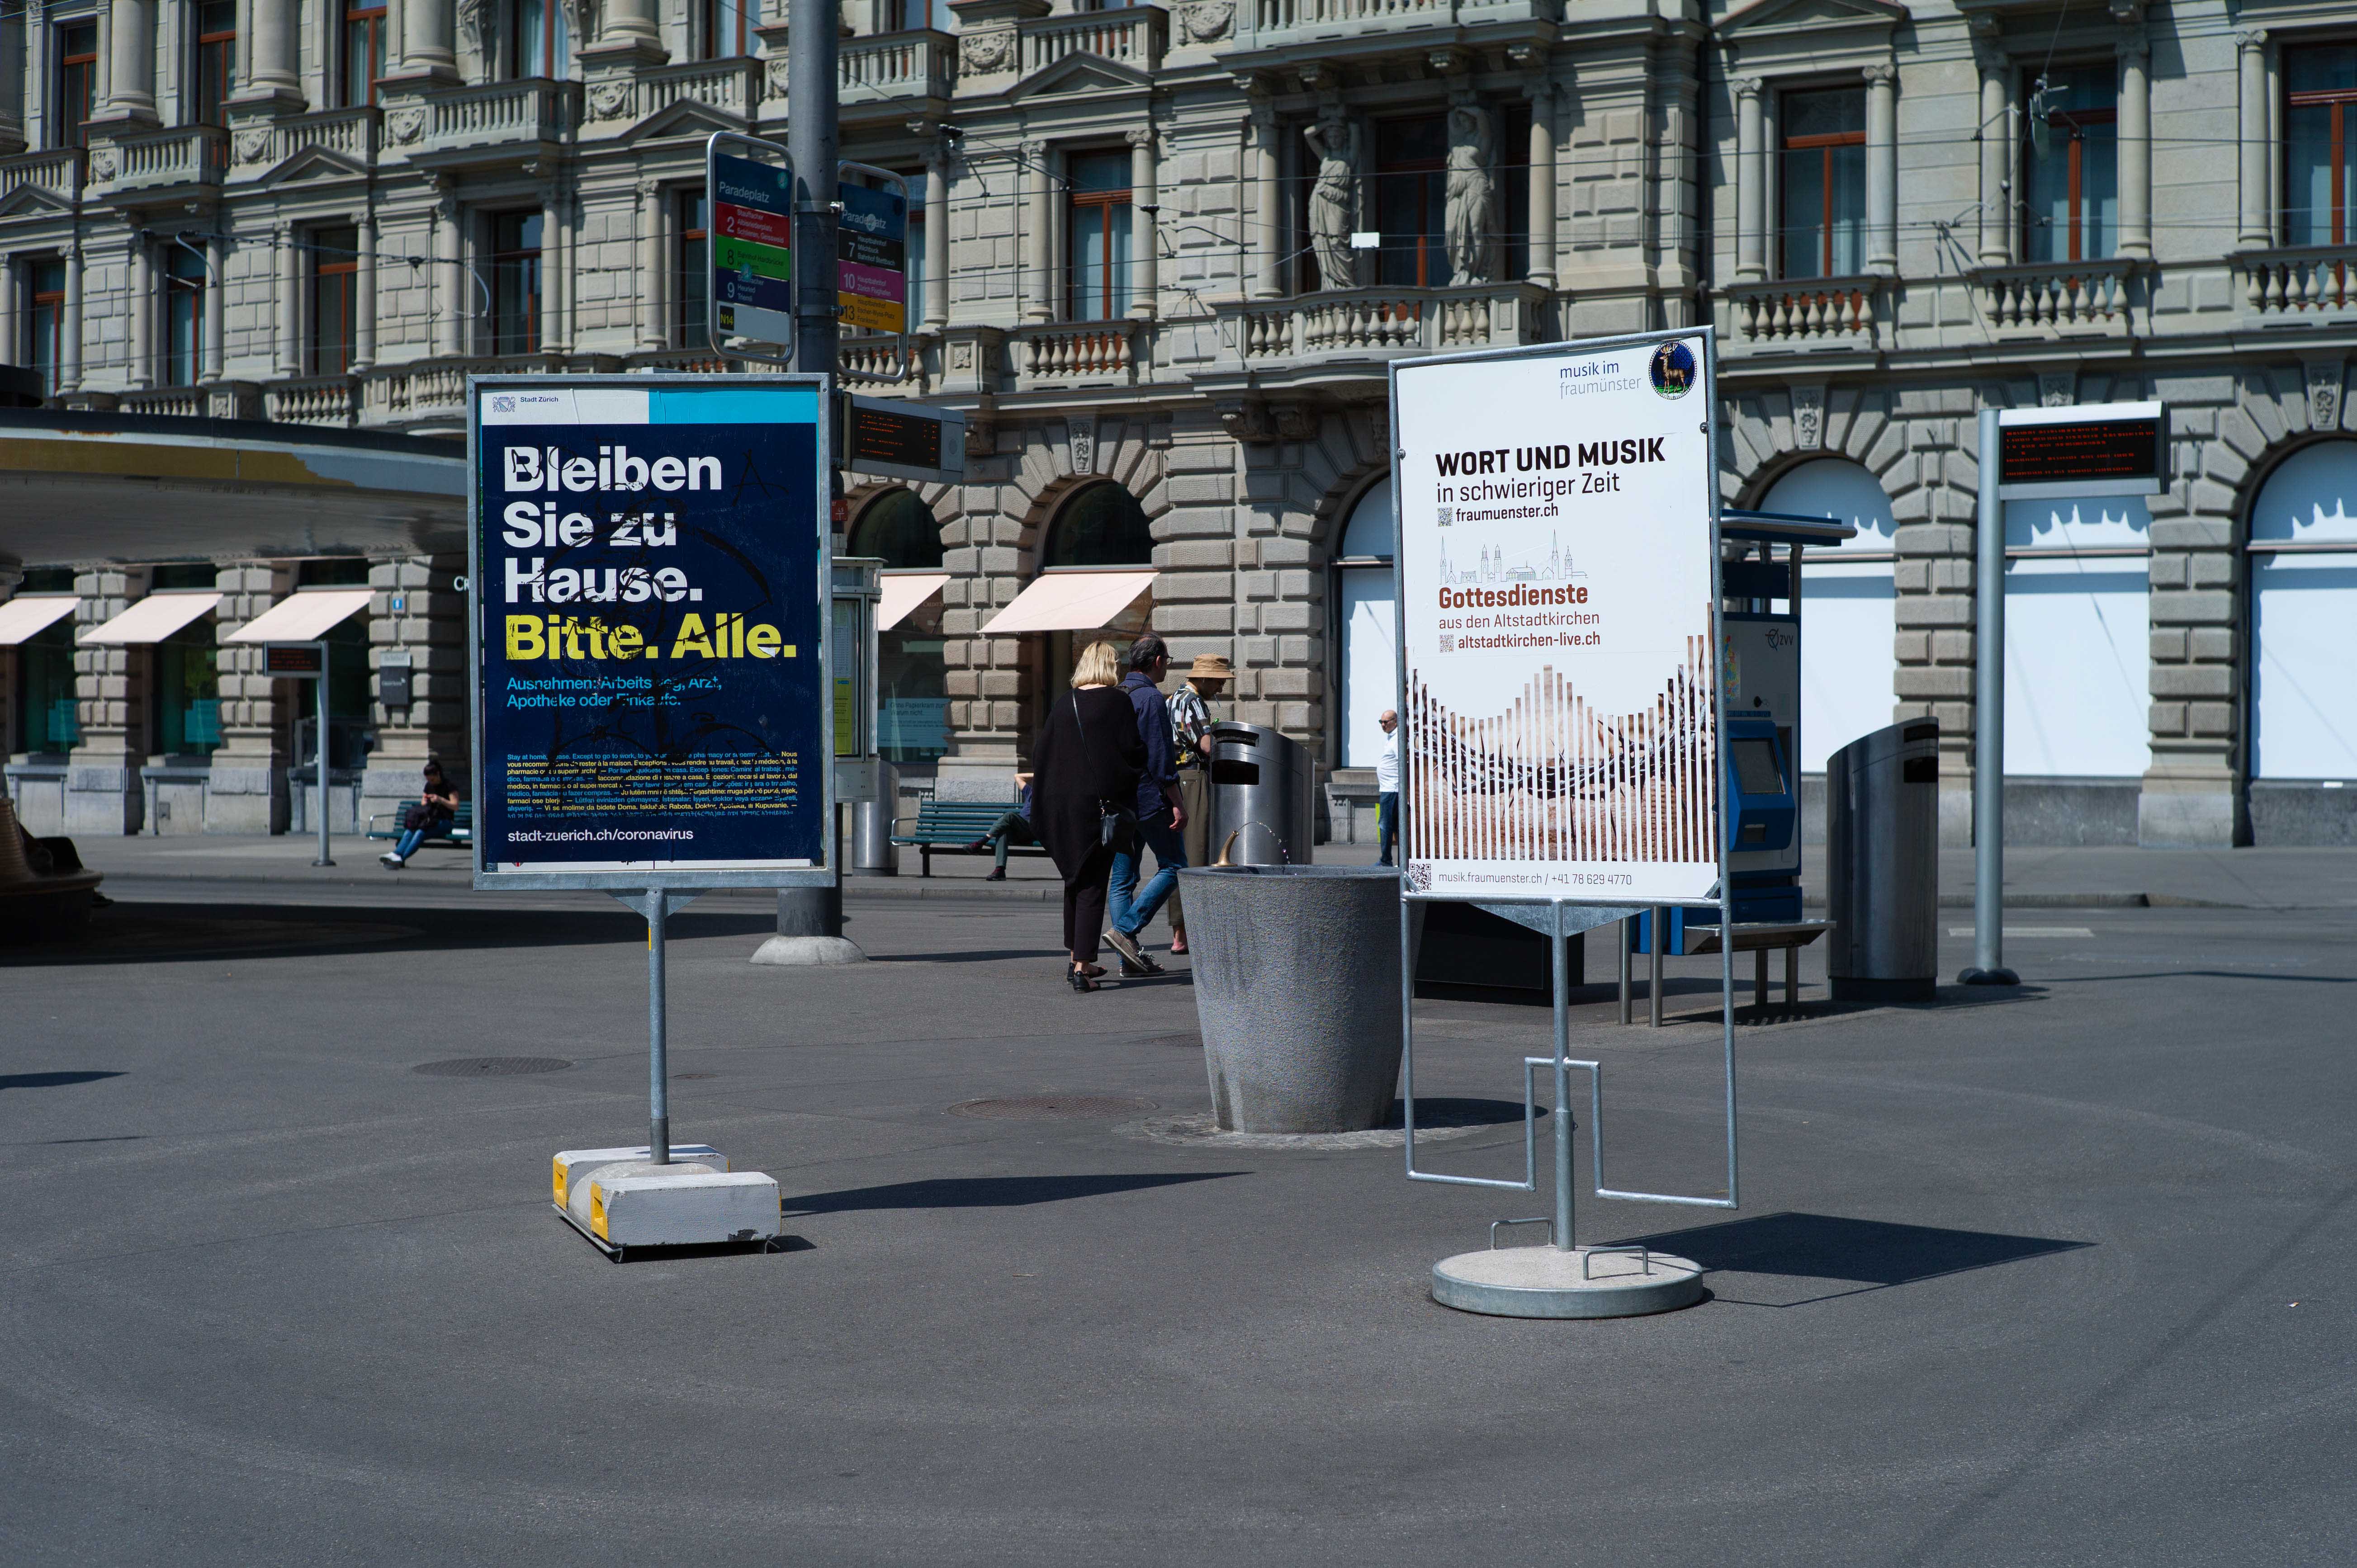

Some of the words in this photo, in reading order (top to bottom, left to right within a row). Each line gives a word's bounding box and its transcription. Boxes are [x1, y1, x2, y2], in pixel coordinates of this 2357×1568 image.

[719, 182, 769, 203] Paradeplatz
[727, 216, 734, 233] 2
[842, 210, 886, 229] Paradeatz
[727, 250, 734, 265] 8
[849, 242, 855, 257] 7
[727, 282, 734, 298] 9
[843, 273, 855, 289] 10
[720, 313, 734, 325] N14
[843, 305, 855, 321] 13
[1560, 362, 1600, 378] musik
[1603, 360, 1619, 374] im
[1560, 375, 1642, 400] fraumünster
[1435, 449, 1510, 477] WORT
[1516, 444, 1570, 472] UND
[1578, 437, 1666, 468] MUSIK
[504, 446, 722, 492] Bleiben
[1437, 482, 1453, 503] in
[1460, 476, 1576, 504] schwieriger
[1582, 471, 1620, 494] Zeit
[1456, 502, 1558, 522] fraumuenster.ch
[502, 501, 594, 548] Sie
[610, 513, 676, 547] zu
[505, 557, 702, 603] Hause.
[1439, 583, 1588, 609] Gottesdienste
[1439, 619, 1462, 629] aus
[1466, 614, 1490, 628] den
[1494, 611, 1600, 628] Altstadtkirchen
[506, 614, 658, 660] Bitte.
[670, 613, 796, 658] Alle.
[1458, 631, 1600, 649] altstadtkirchen-live.ch
[1780, 635, 1794, 646] ZVV
[506, 677, 596, 690] Ausnahmen:
[601, 676, 685, 692] Arbeitsg,
[688, 676, 722, 690] Arzt,
[506, 694, 576, 710] Apotheke
[579, 694, 614, 707] oder
[508, 828, 694, 841] stadt-zuerich.ch/coronavirus
[1439, 872, 1542, 883] musik.fraumuenster.ch
[1545, 873, 1548, 886] /
[1552, 874, 1569, 884] +41
[1572, 874, 1584, 884] 78
[1587, 874, 1604, 884] 629
[1608, 874, 1632, 885] 4770
